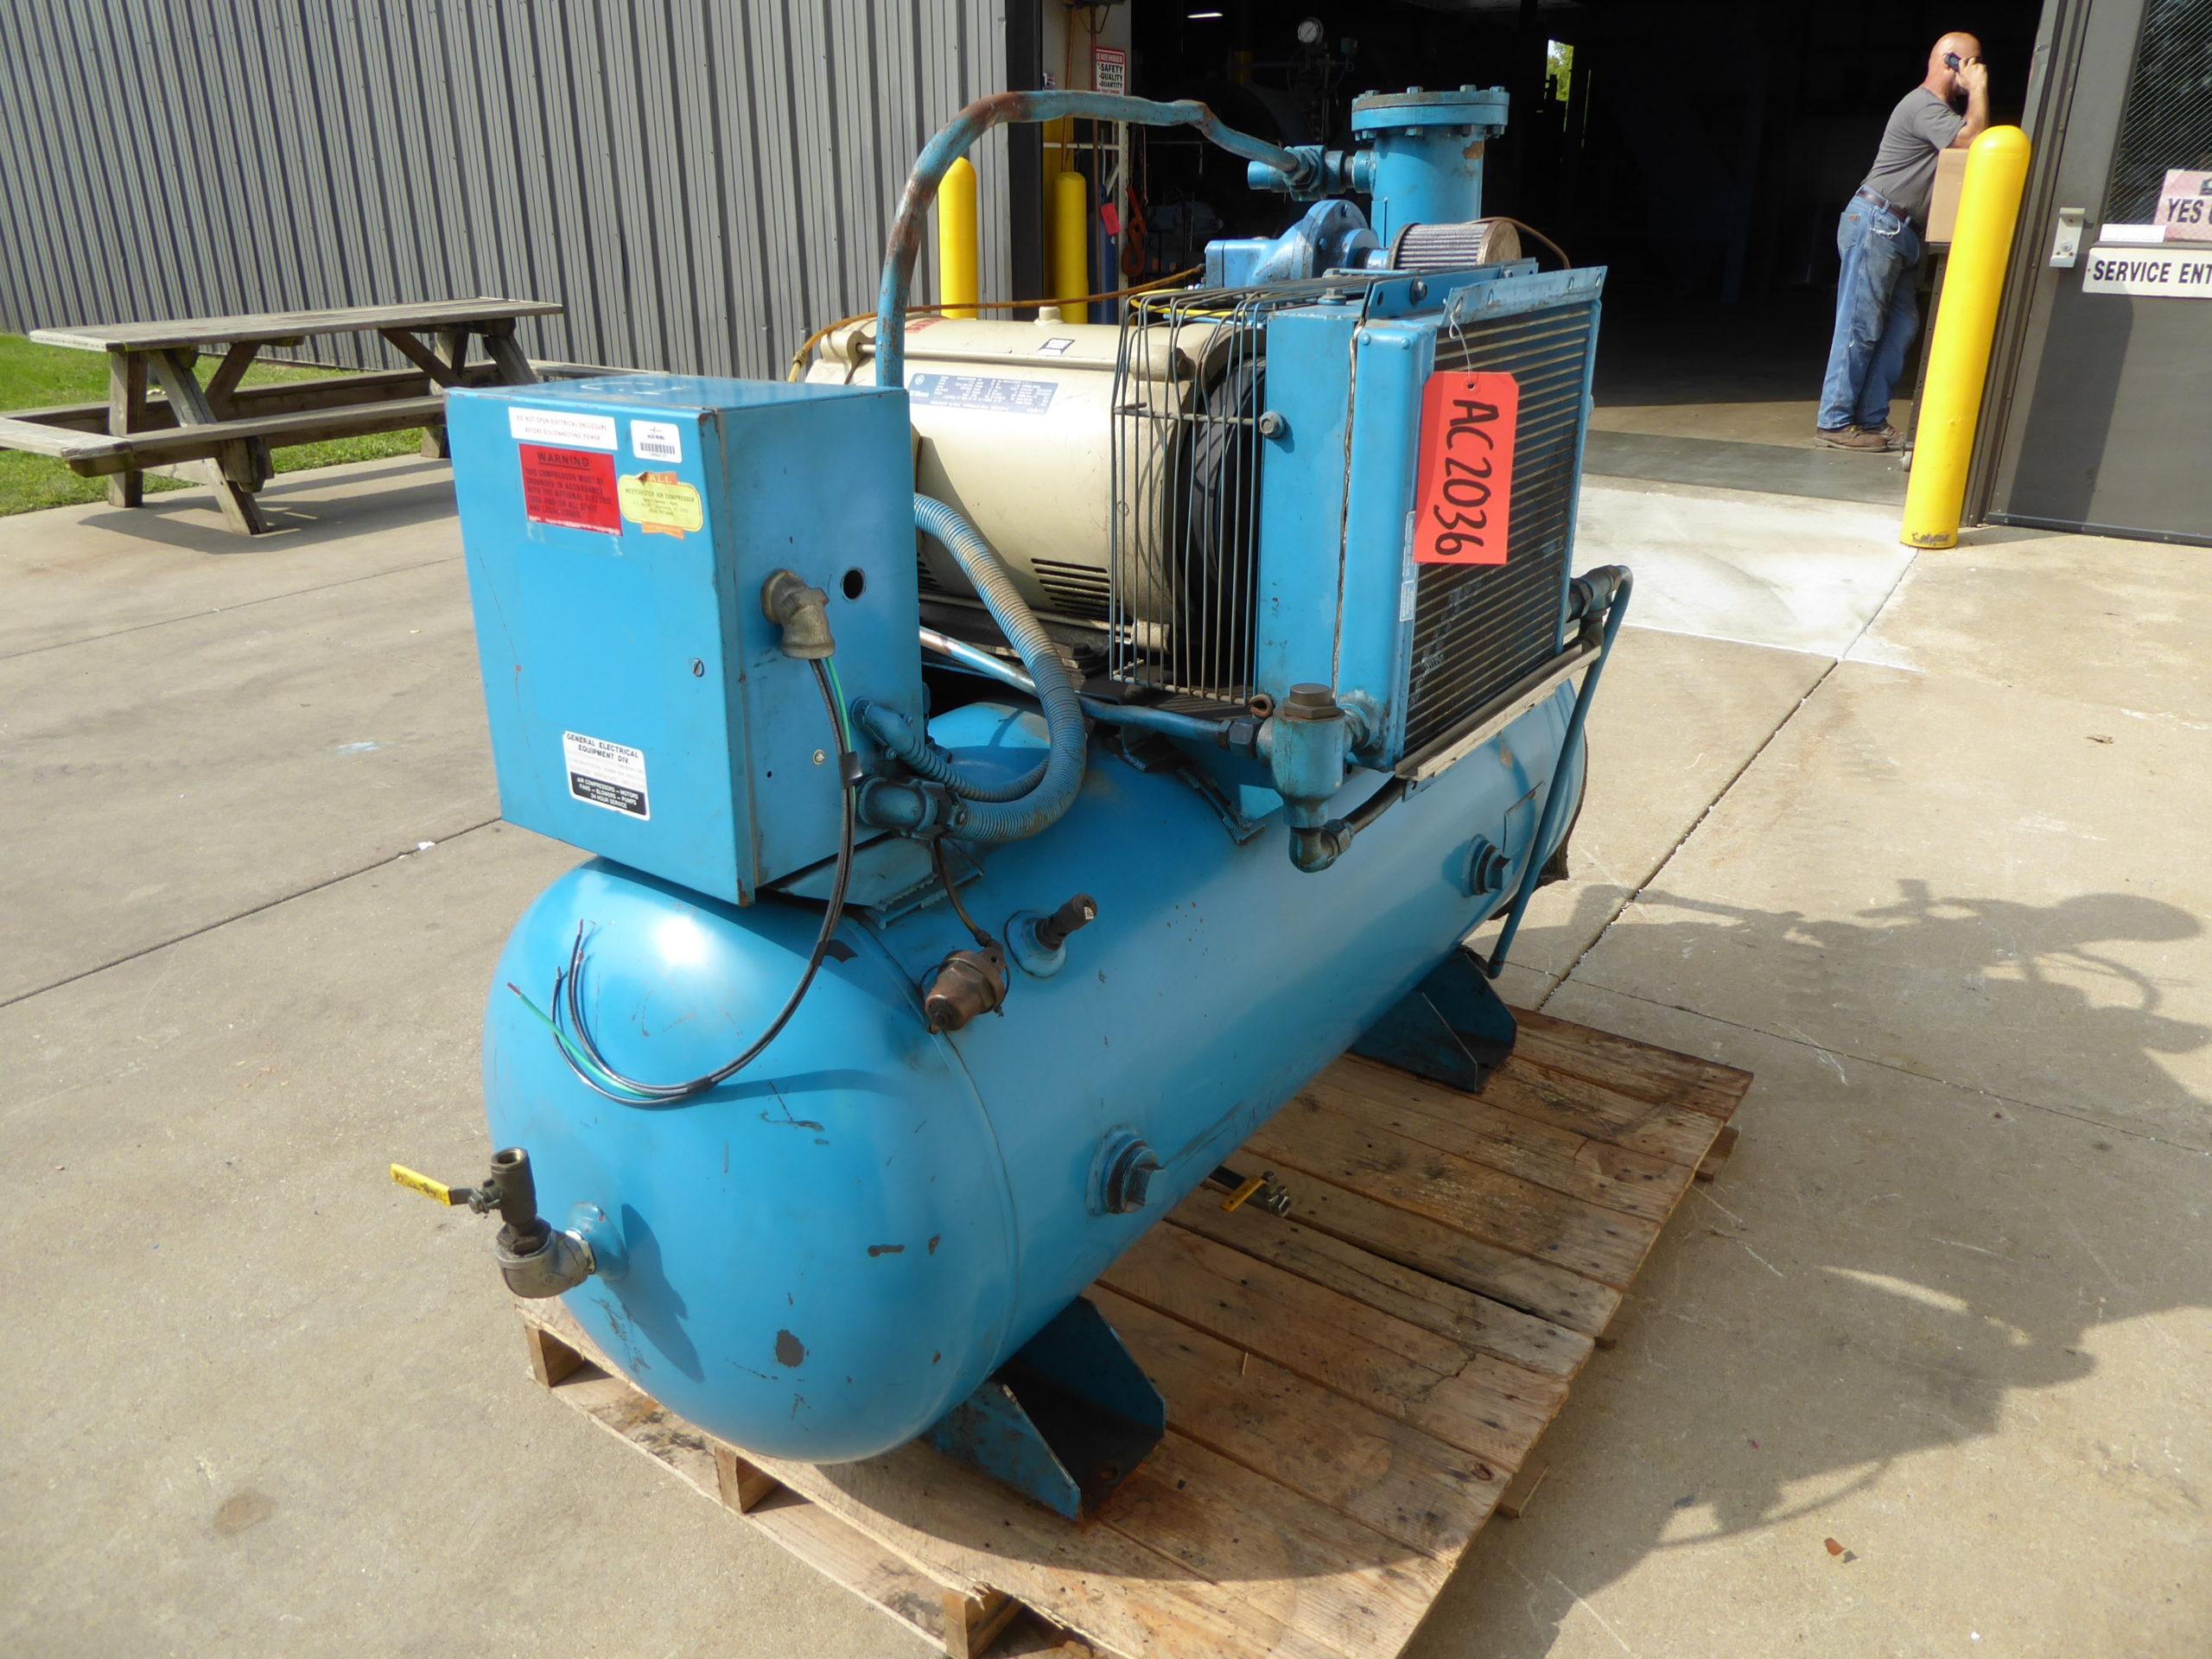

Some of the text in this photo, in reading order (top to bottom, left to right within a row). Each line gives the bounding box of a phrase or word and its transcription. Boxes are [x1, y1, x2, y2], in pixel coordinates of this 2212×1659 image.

[2167, 198, 2204, 224] YES
[2093, 260, 2171, 283] SERVICE
[537, 452, 589, 467] WARNING
[1433, 399, 1499, 556] AC2036
[566, 733, 639, 759] GENERAL ELECTRICAL
[578, 744, 614, 760] EQUIPMENT
